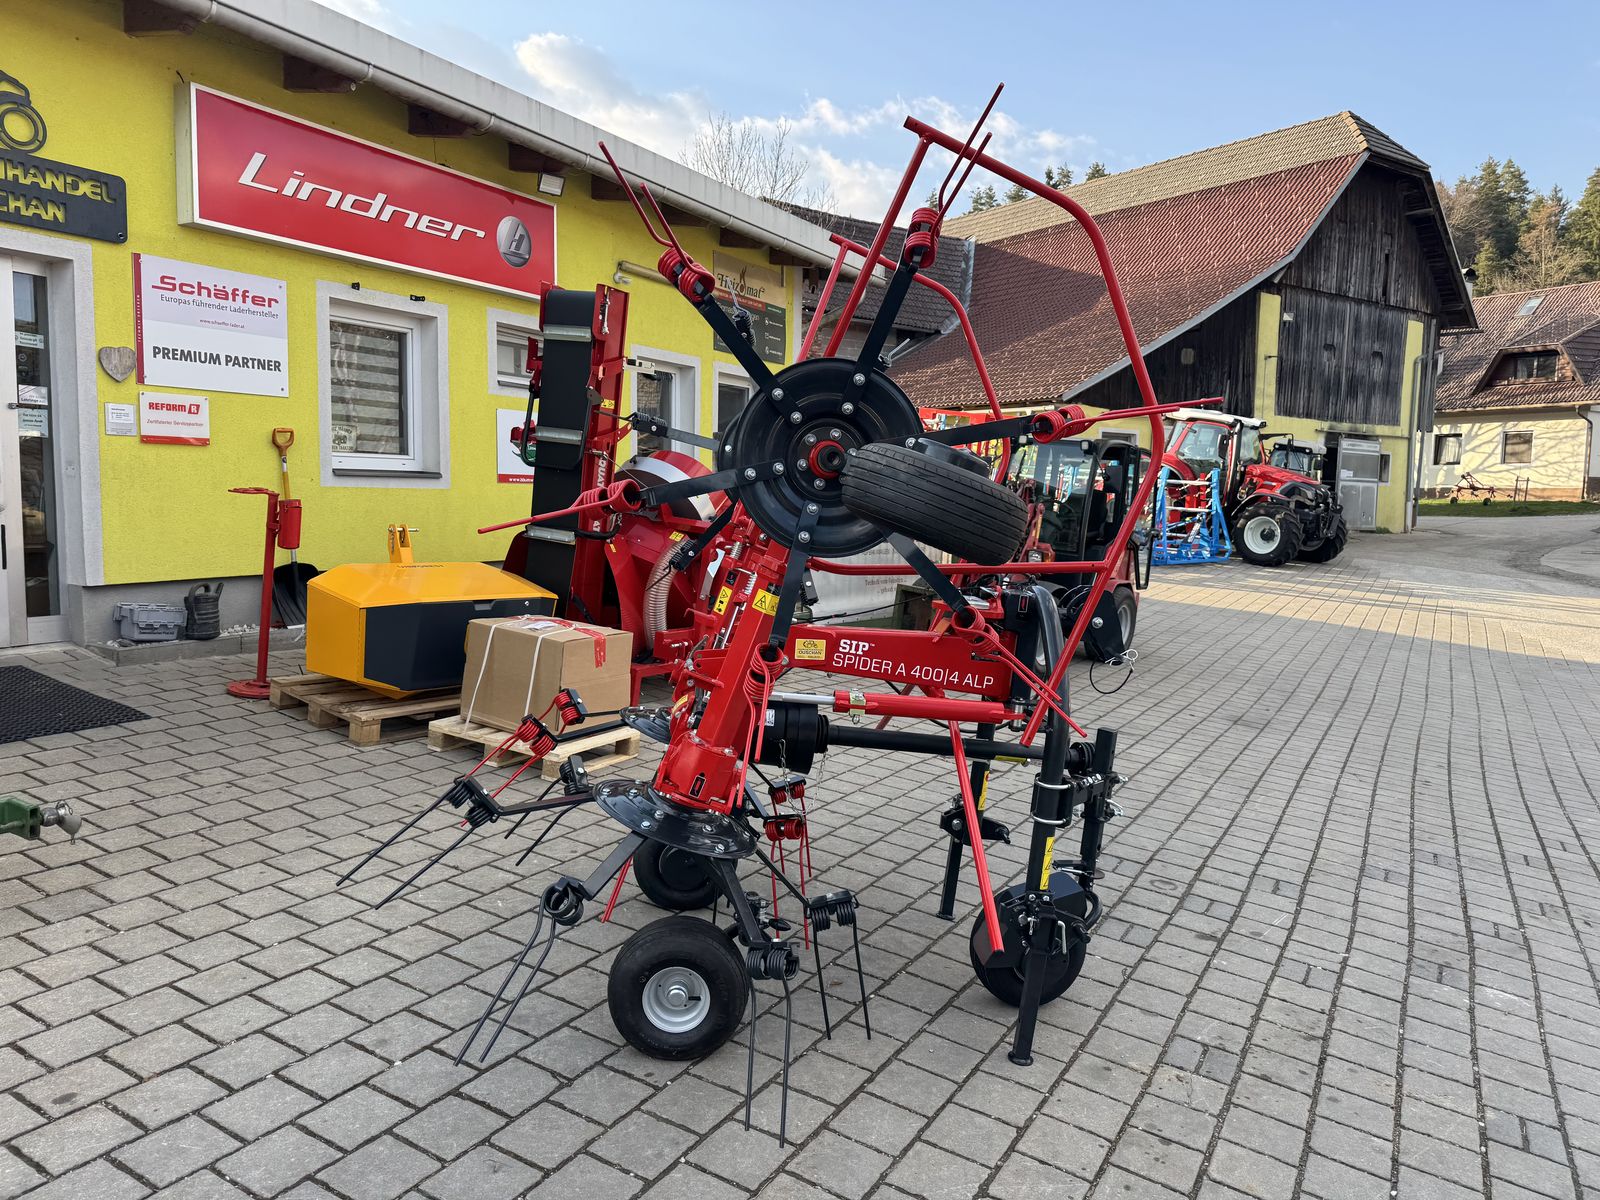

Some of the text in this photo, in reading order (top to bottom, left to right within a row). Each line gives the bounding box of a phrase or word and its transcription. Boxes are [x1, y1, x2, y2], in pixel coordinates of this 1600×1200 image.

[0, 159, 116, 204] HANDEL
[238, 152, 486, 241] Lindner
[152, 275, 279, 308] Schäffer
[160, 294, 279, 319] Europas führender Laderhersteller
[152, 345, 282, 373] PREMIUM PARTNER
[148, 401, 187, 412] REFORM
[832, 653, 893, 675] SPIDER
[895, 662, 907, 677] A
[962, 673, 994, 689] ALP
